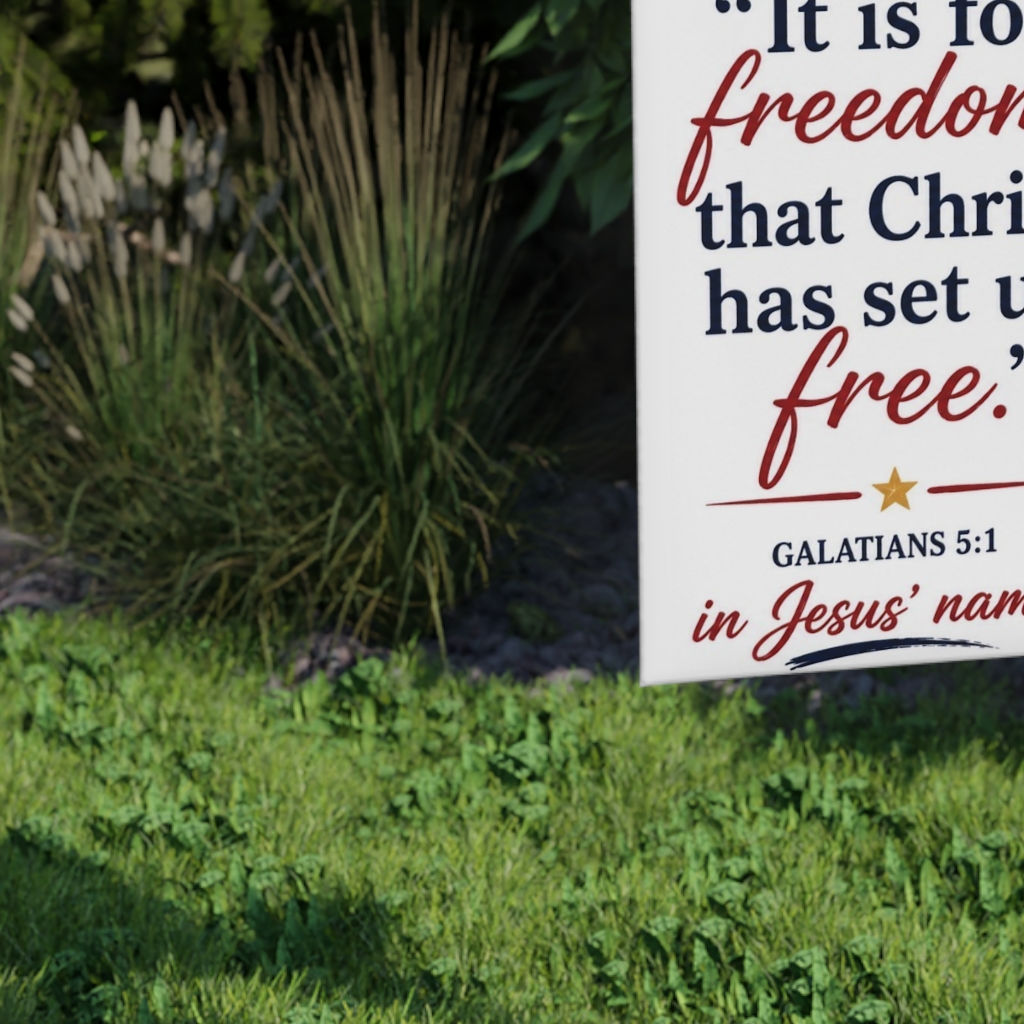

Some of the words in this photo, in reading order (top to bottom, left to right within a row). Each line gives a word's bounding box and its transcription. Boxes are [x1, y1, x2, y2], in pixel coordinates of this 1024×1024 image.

[695, 180, 845, 251] that
[704, 267, 836, 336] has
[863, 265, 971, 328] set
[772, 530, 946, 568] GALATIANS
[955, 527, 997, 555] 5:1
[691, 599, 749, 643] in
[751, 579, 920, 662] Jesus’
